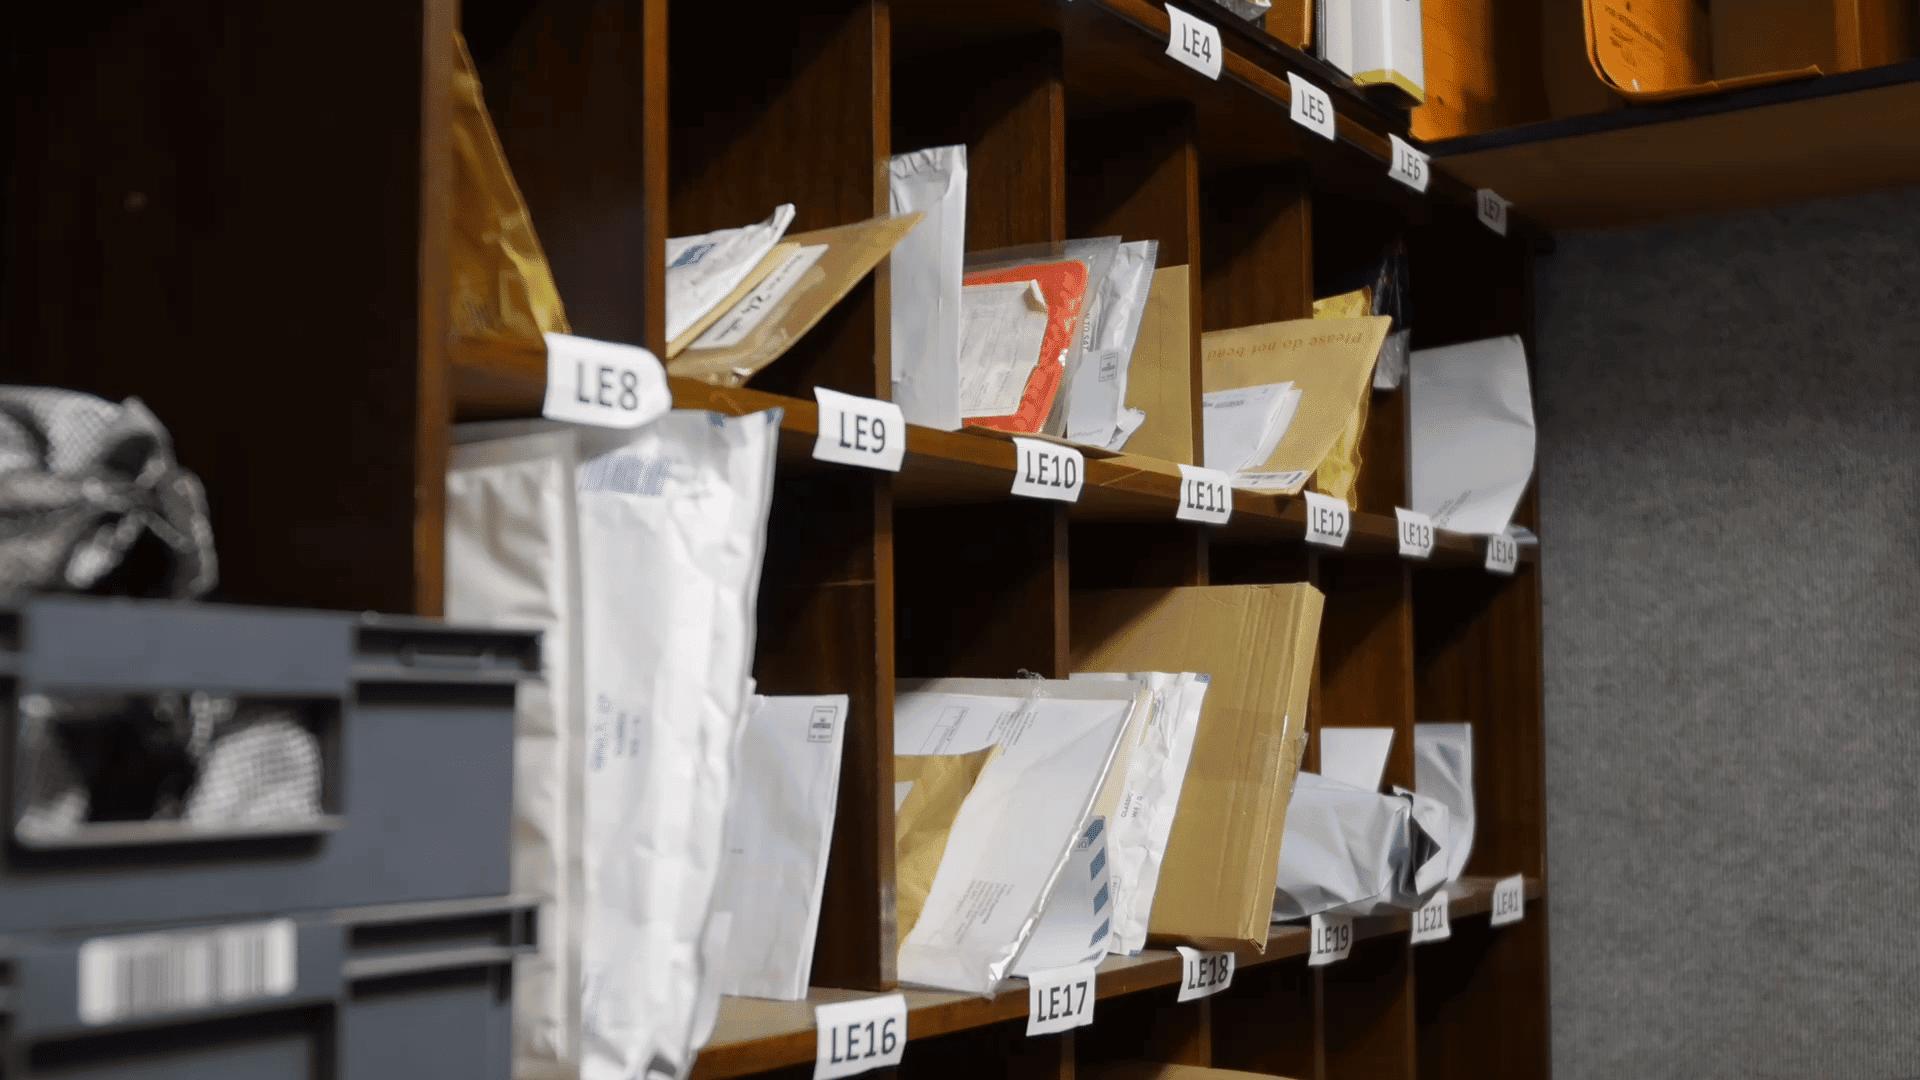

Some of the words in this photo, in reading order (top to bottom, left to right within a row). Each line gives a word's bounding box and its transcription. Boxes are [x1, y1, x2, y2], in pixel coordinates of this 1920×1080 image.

[1181, 22, 1212, 64] LE4
[1300, 89, 1326, 125] LE5
[1399, 149, 1422, 181] LE6
[1482, 195, 1502, 222] LE7
[1206, 347, 1244, 363] bend
[1252, 340, 1280, 355] not
[1282, 337, 1303, 351] do
[1311, 331, 1363, 347] Please
[576, 361, 639, 411] LE8
[838, 410, 886, 454] LE9
[1025, 450, 1077, 489] LE10
[1186, 479, 1226, 513] LE11
[1312, 506, 1345, 539] LE12
[1402, 521, 1431, 550] LE13
[1489, 539, 1515, 565] LE14
[1495, 888, 1520, 916] LE41
[1416, 906, 1443, 934] LE21
[1316, 924, 1349, 955] LE19
[1187, 953, 1229, 990] LE18
[1036, 980, 1088, 1023] LE17
[829, 1016, 898, 1065] LE16
